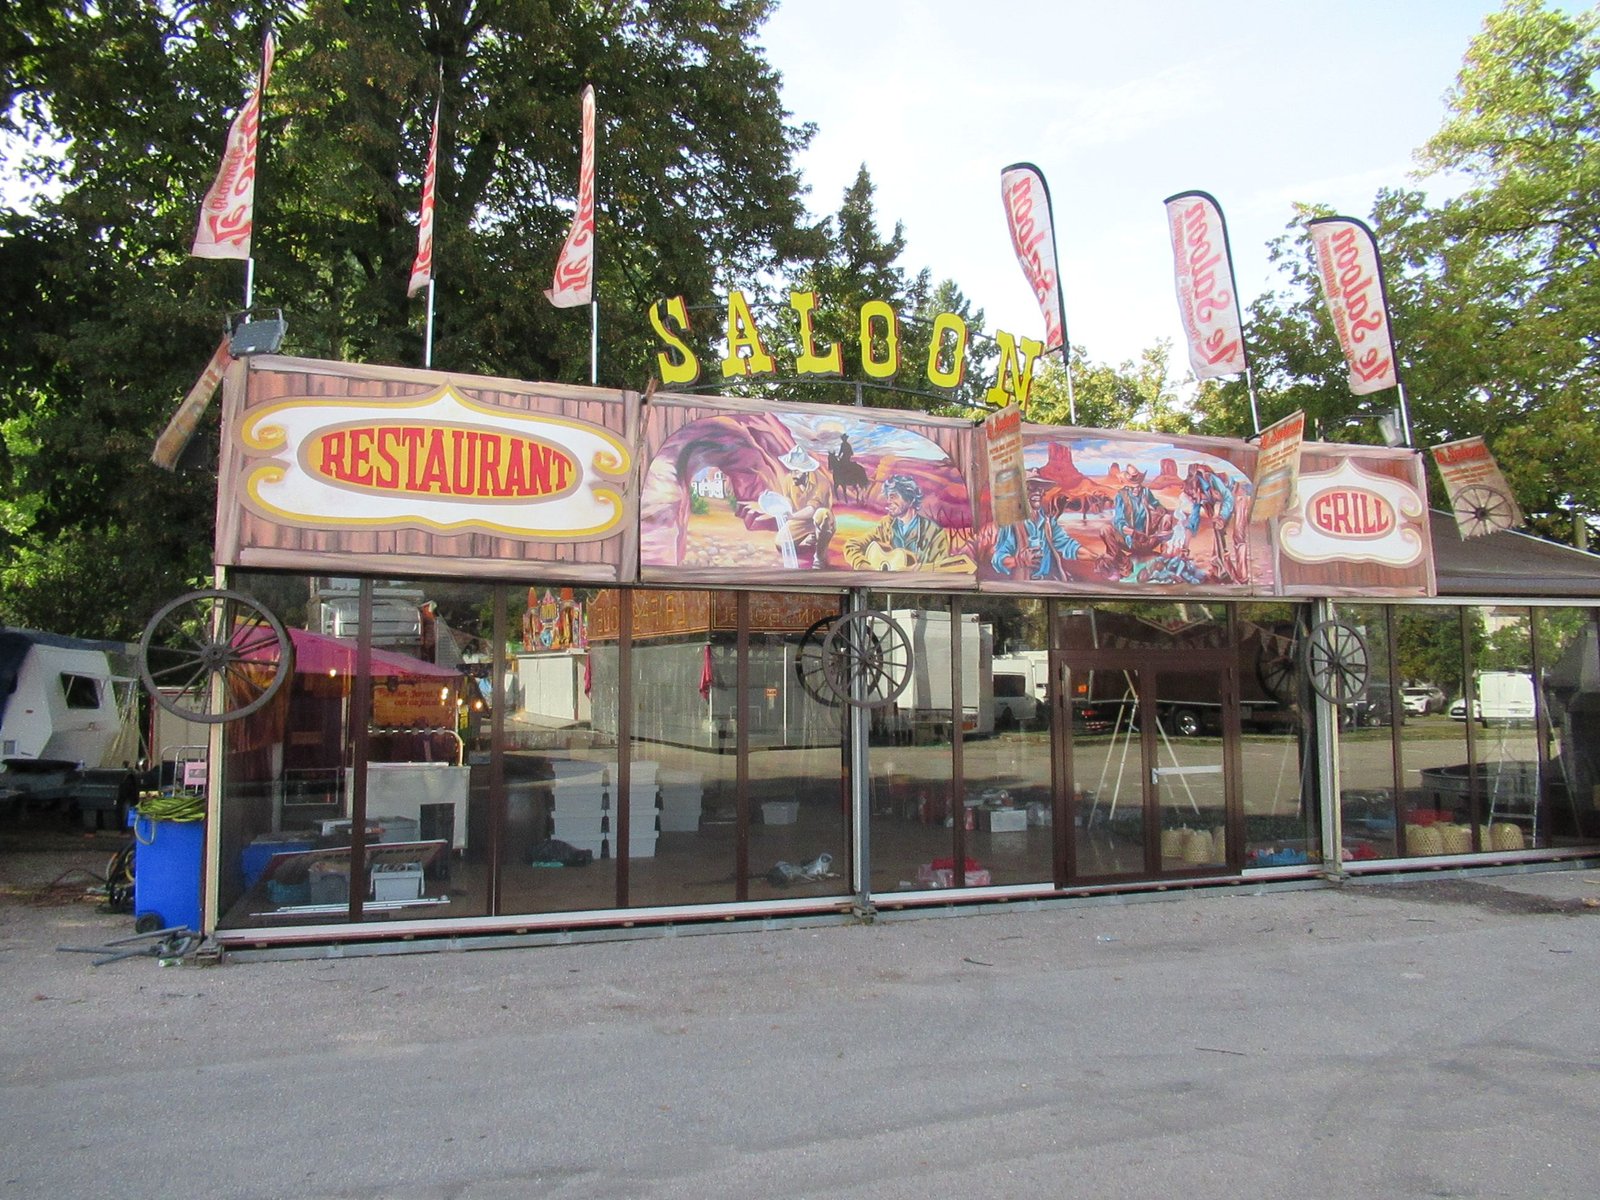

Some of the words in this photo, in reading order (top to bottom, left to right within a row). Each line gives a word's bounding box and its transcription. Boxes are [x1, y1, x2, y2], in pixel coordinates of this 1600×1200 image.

[648, 289, 1044, 410] SALOON
[320, 427, 572, 497] RESTAURANT
[1315, 492, 1390, 534] GRILL
